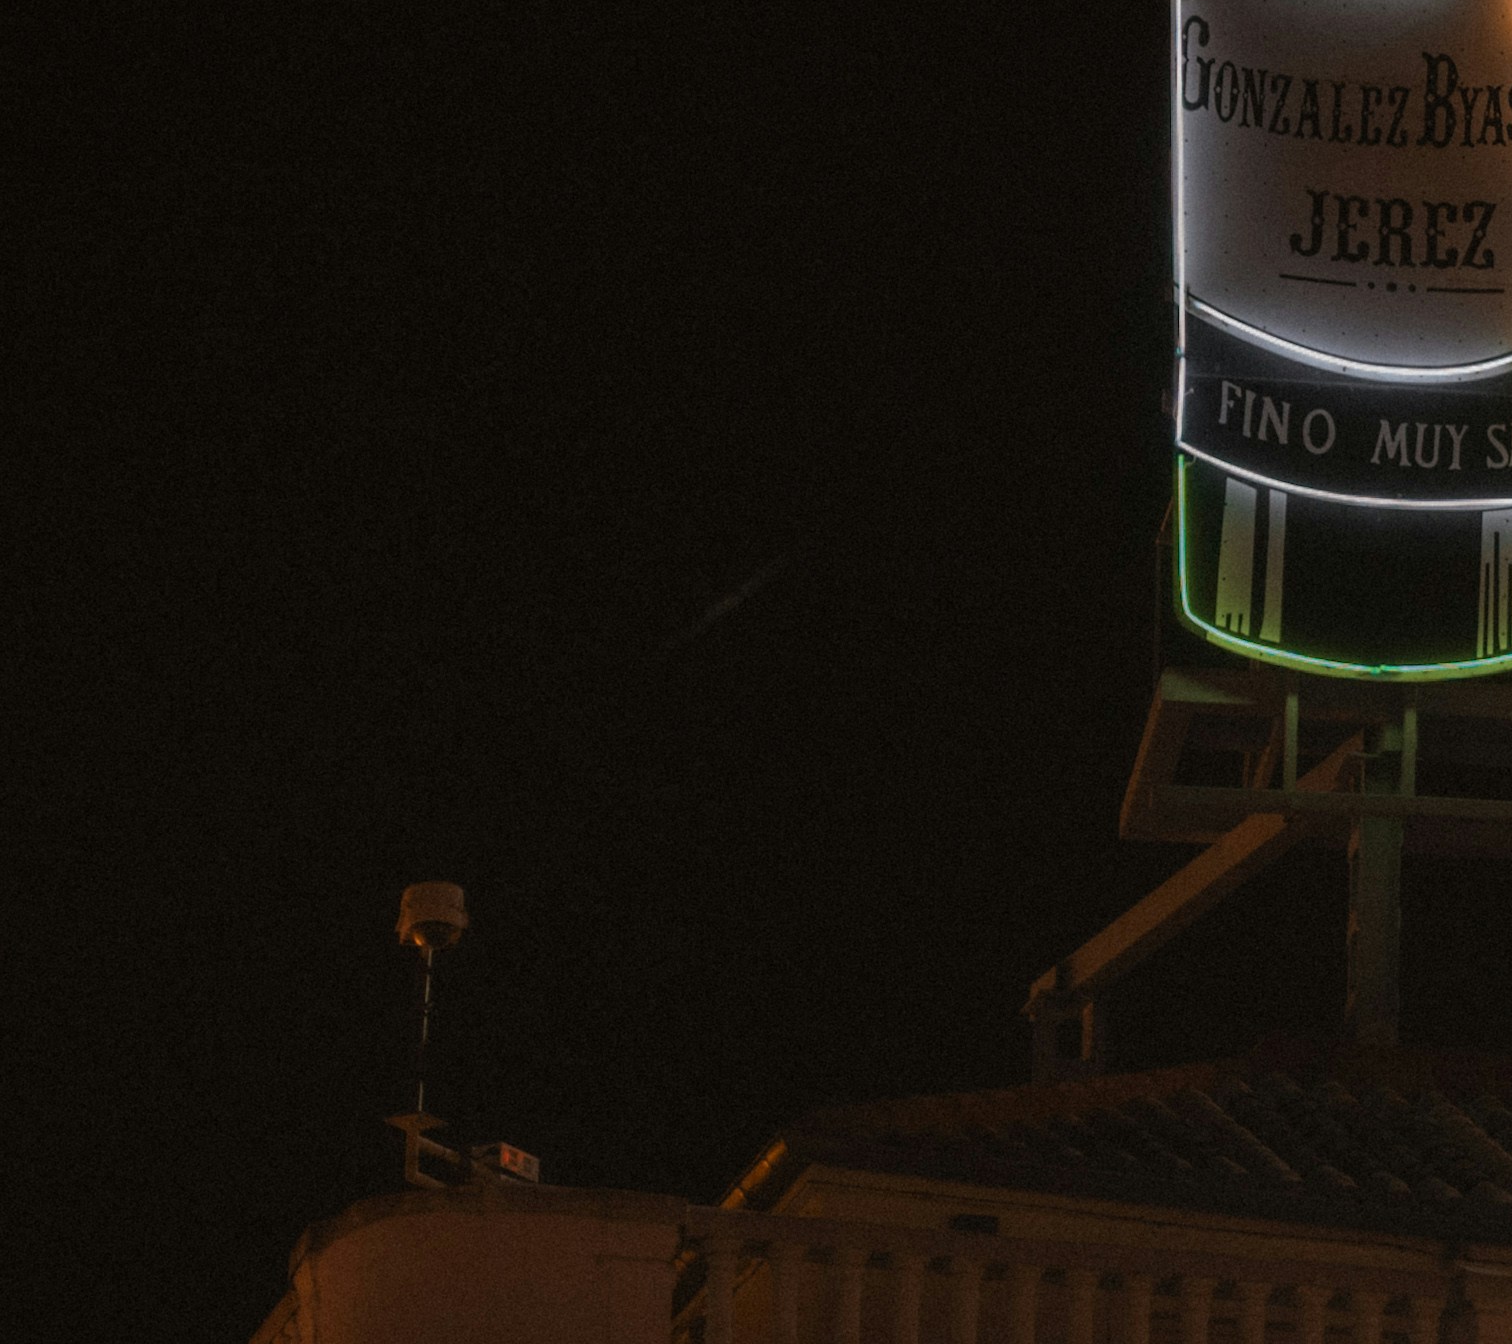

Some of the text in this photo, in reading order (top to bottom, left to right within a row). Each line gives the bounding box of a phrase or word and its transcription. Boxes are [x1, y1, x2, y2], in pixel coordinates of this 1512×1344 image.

[1181, 15, 1412, 148] GONZALEZ
[1289, 189, 1498, 270] JEREZ
[1217, 380, 1336, 456] FINO
[1370, 419, 1469, 471] MUY
